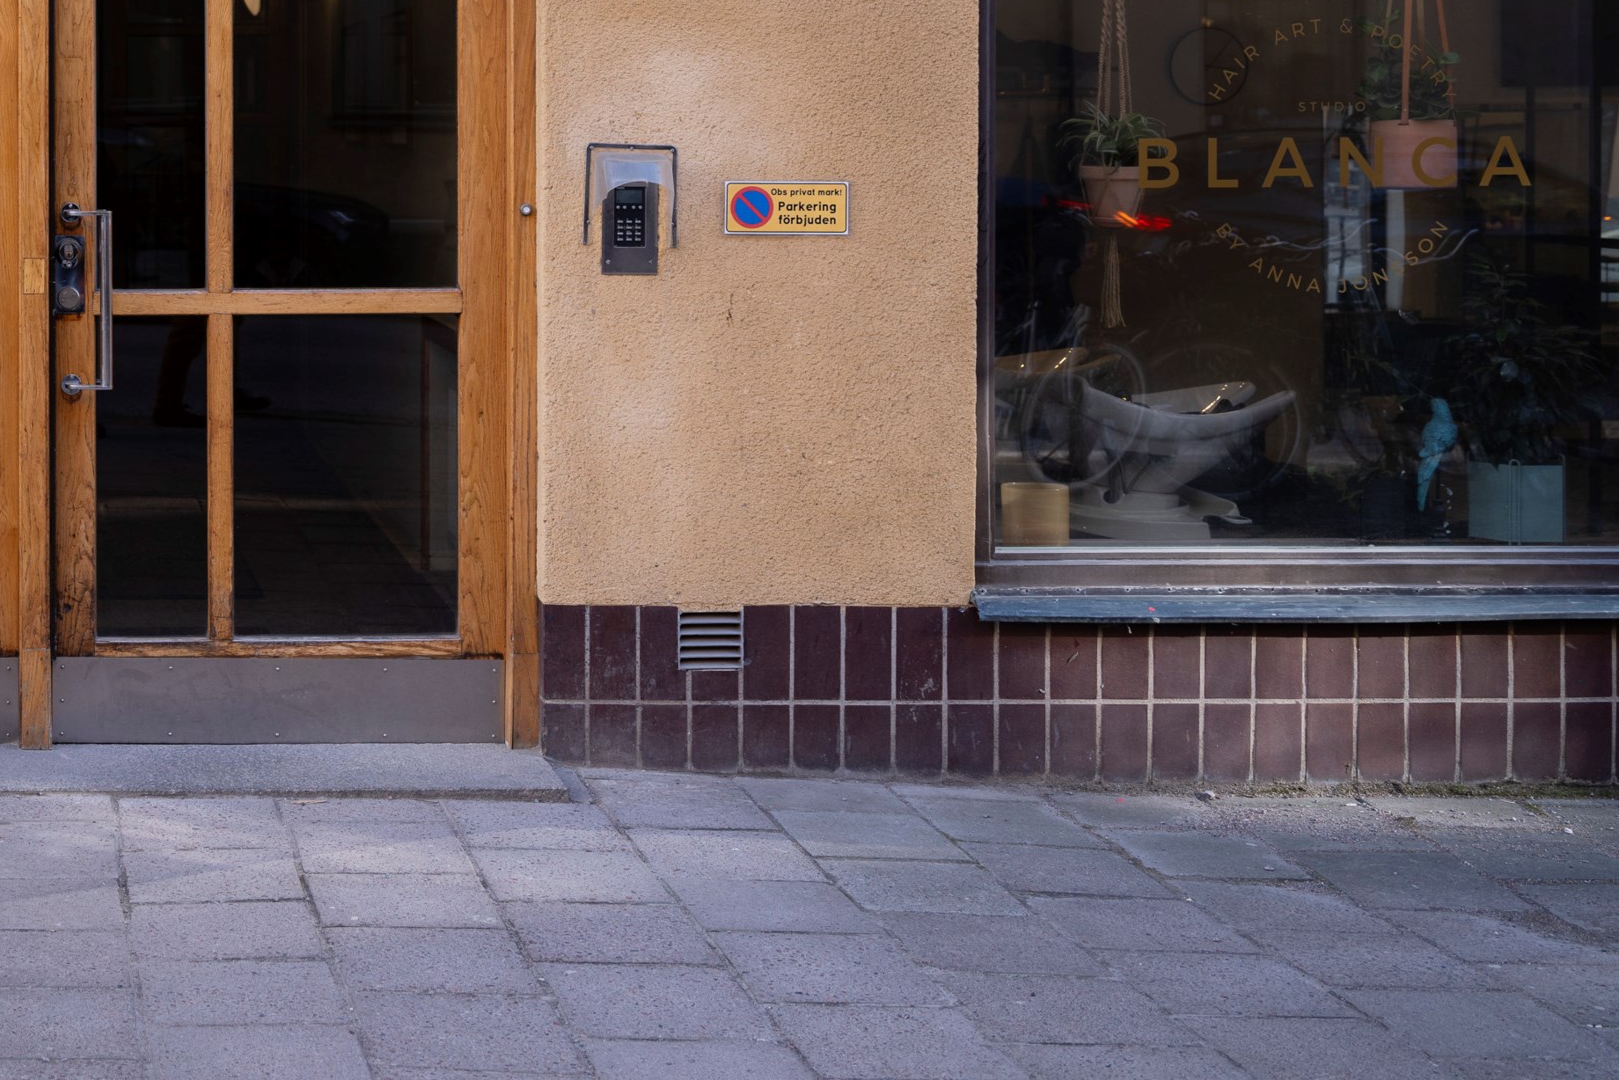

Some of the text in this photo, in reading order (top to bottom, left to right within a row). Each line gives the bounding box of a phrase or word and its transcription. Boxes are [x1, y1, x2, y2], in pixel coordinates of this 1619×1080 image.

[1208, 18, 1457, 101] HAIR ART & POETRY
[1298, 101, 1366, 112] STUDIO
[1137, 136, 1531, 188] BLANCA
[771, 188, 842, 197] Obs privat mark!
[778, 201, 836, 213] Parkering
[778, 215, 836, 227] förbjuden
[1215, 222, 1248, 252] BY
[1249, 258, 1321, 294] ANNA
